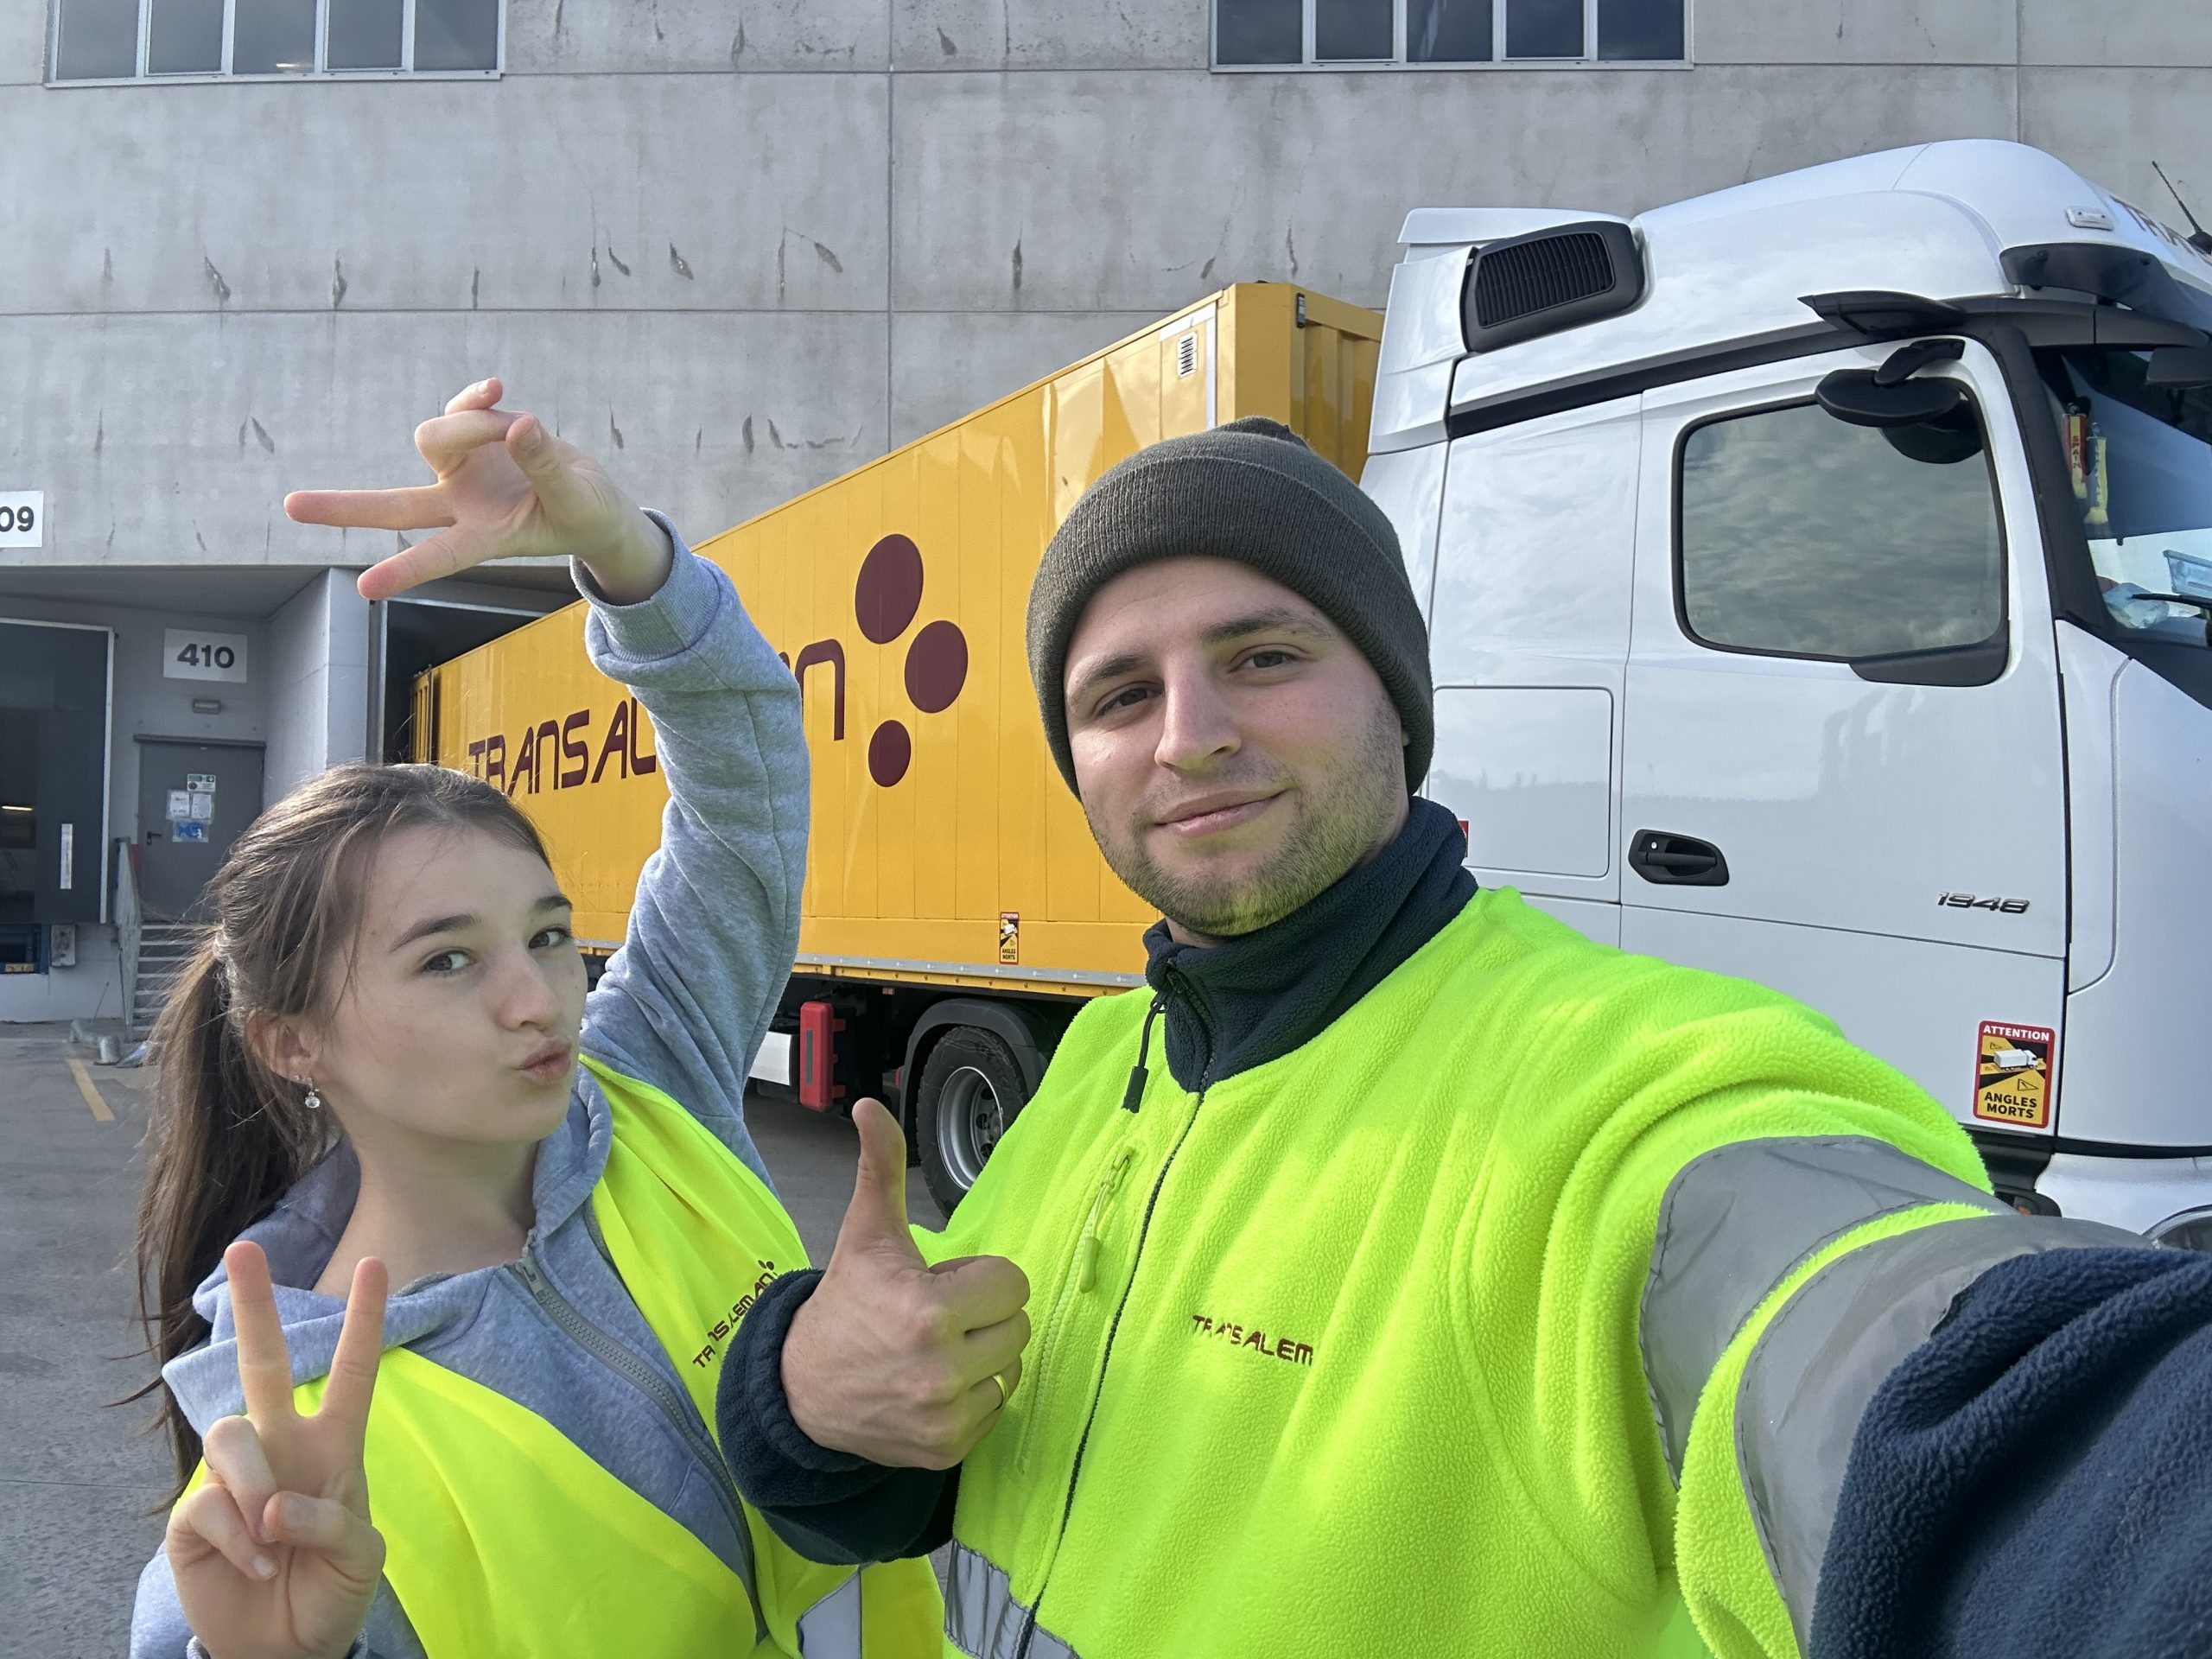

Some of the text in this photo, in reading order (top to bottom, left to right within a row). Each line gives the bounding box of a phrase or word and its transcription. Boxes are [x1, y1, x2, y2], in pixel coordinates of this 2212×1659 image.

[177, 643, 235, 669] 410
[468, 639, 846, 797] TRANSALN
[1938, 891, 2030, 914] 1948
[1983, 1025, 2050, 1042] ATTENTION
[1984, 1091, 2037, 1109] ANGLES
[1986, 1103, 2034, 1119] MORTS
[692, 1272, 775, 1369] TRNSLEMAN
